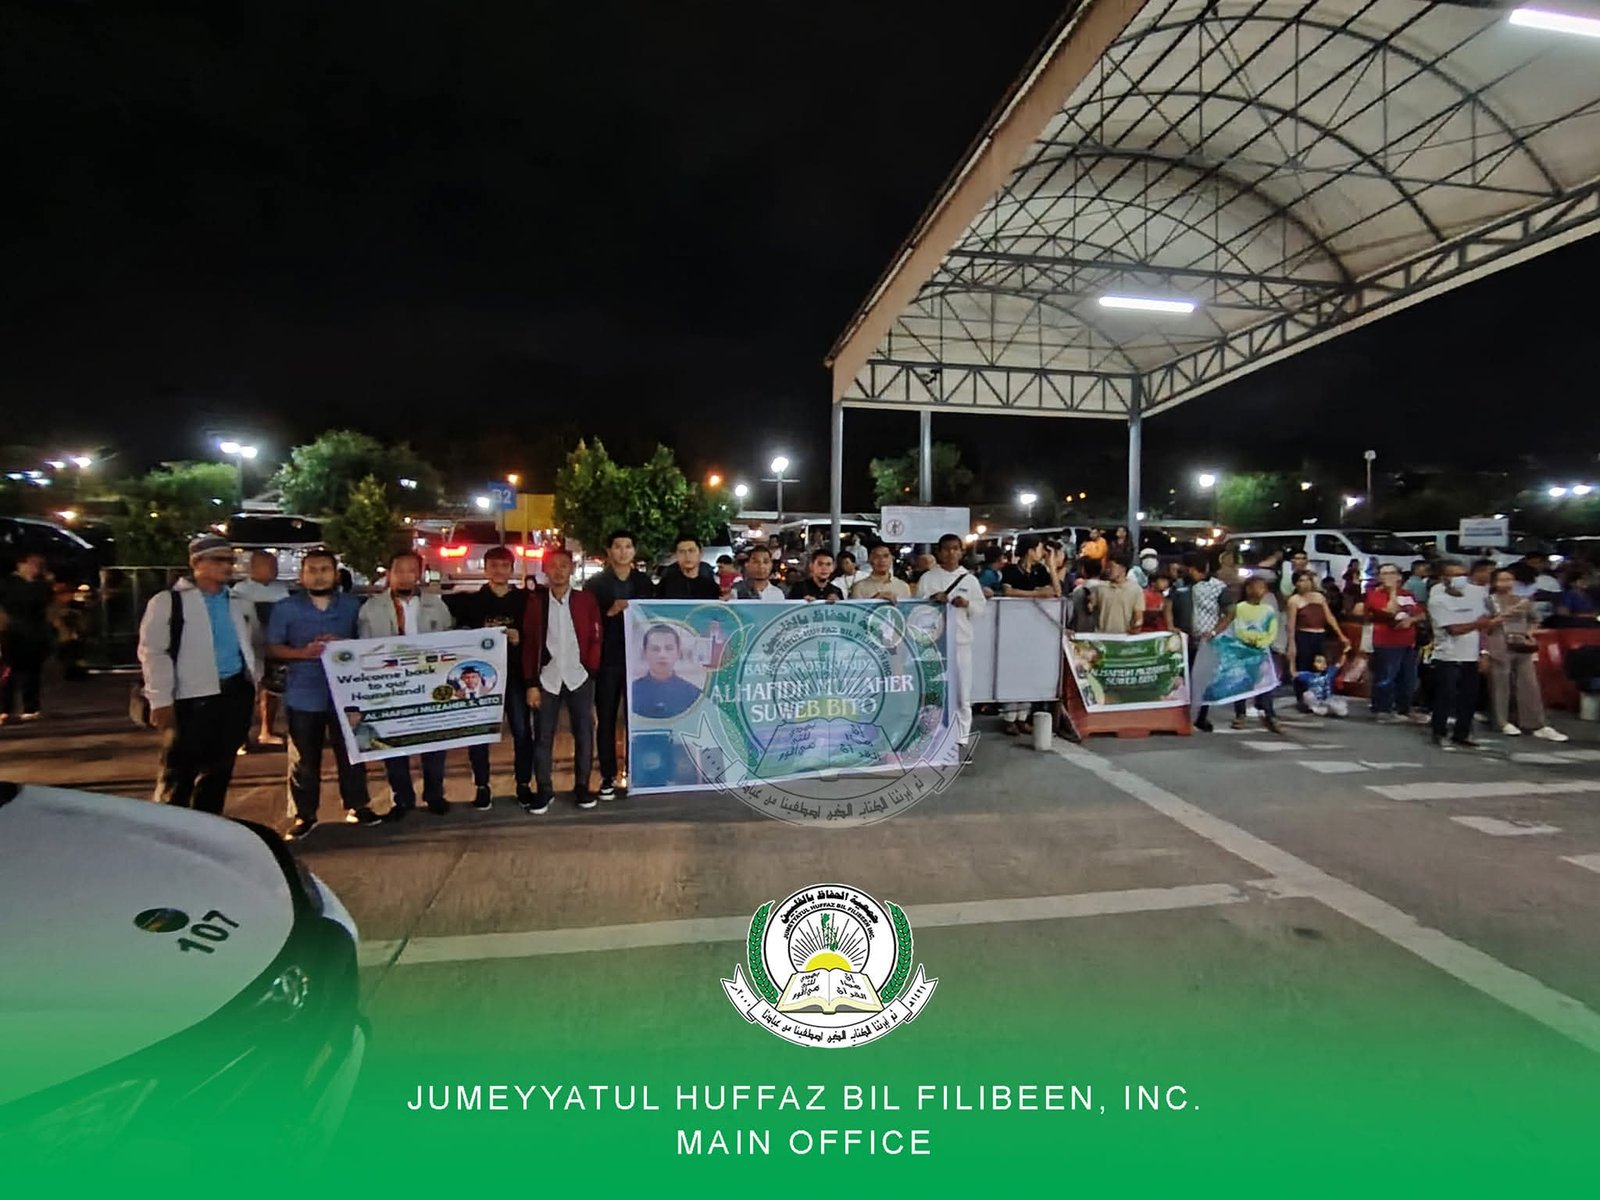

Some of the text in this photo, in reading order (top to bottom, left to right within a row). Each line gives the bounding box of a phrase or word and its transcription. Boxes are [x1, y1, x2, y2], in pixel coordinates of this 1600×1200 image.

[336, 666, 436, 685] Welcome back
[368, 680, 410, 690] to our
[351, 684, 426, 701] Homeland!
[751, 697, 877, 723] SUWEB BITO
[177, 909, 240, 954] 107
